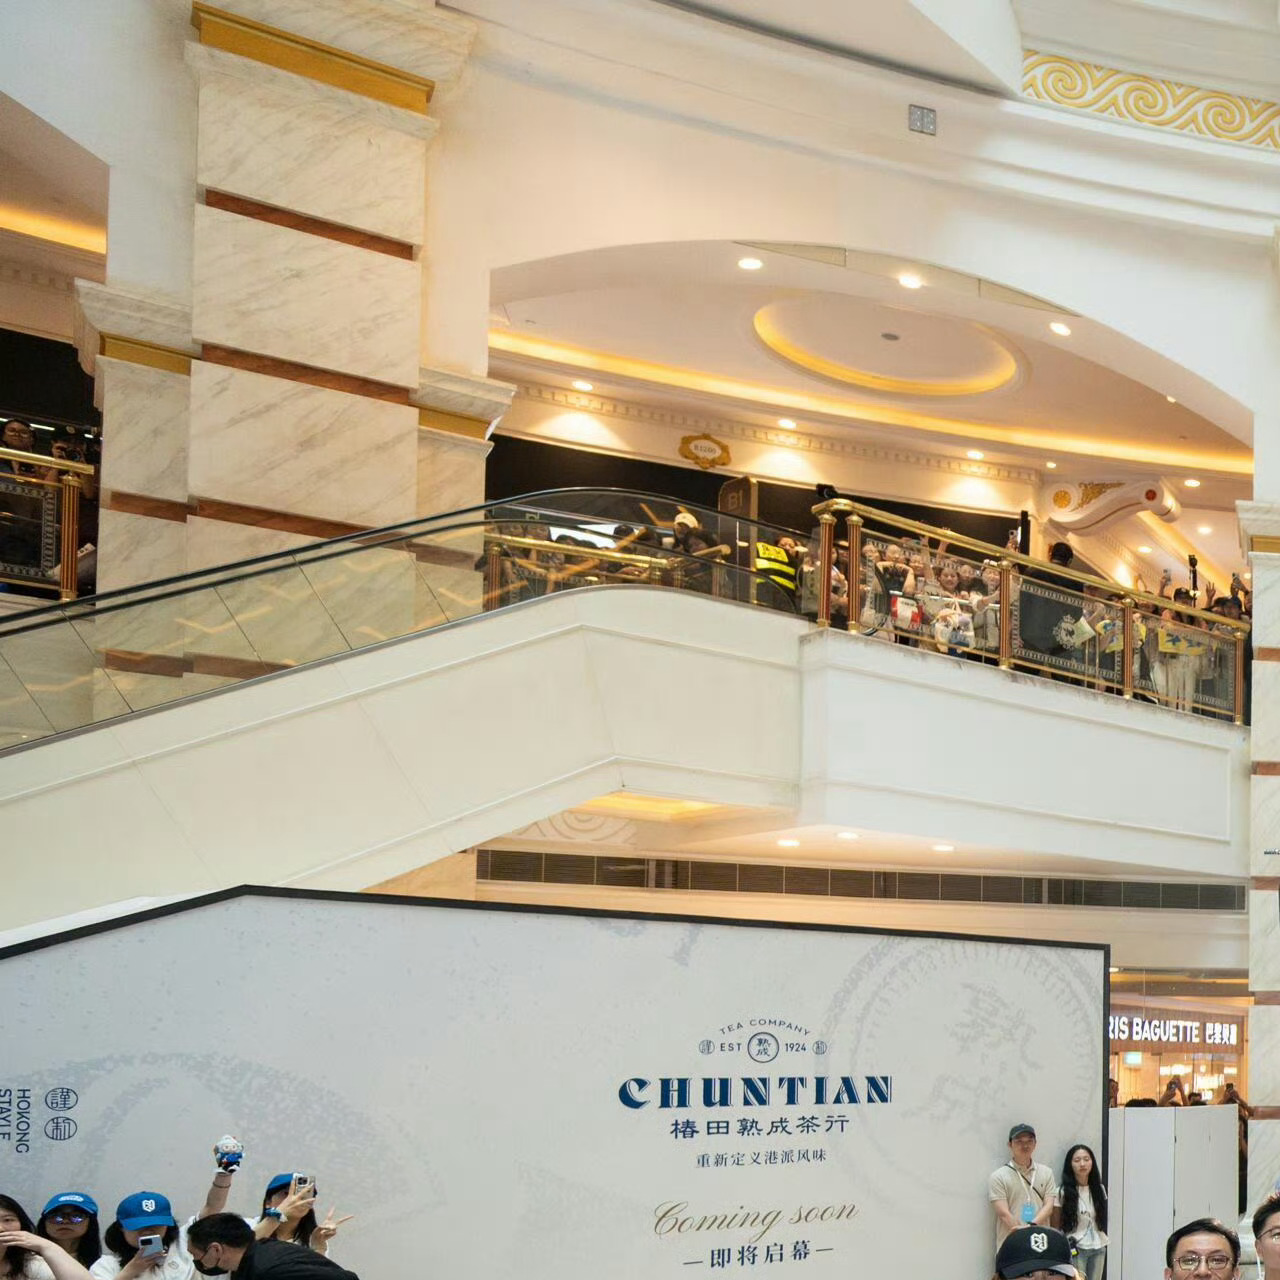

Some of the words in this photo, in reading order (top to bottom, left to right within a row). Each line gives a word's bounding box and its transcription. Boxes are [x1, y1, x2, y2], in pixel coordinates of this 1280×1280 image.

[719, 1022, 744, 1035] TEA
[749, 1018, 811, 1036] COMPANY
[1132, 1017, 1200, 1043] BAGUETTE
[720, 1042, 742, 1052] EST
[785, 1042, 807, 1053] 1924
[618, 1075, 893, 1109] CHUNTIAN
[15, 1088, 31, 1154] HOKONG
[670, 1114, 850, 1139] 椿田熟成茶行
[696, 1148, 827, 1168] 重新定义港派风味
[654, 1200, 785, 1243] Coming
[789, 1201, 859, 1225] soon
